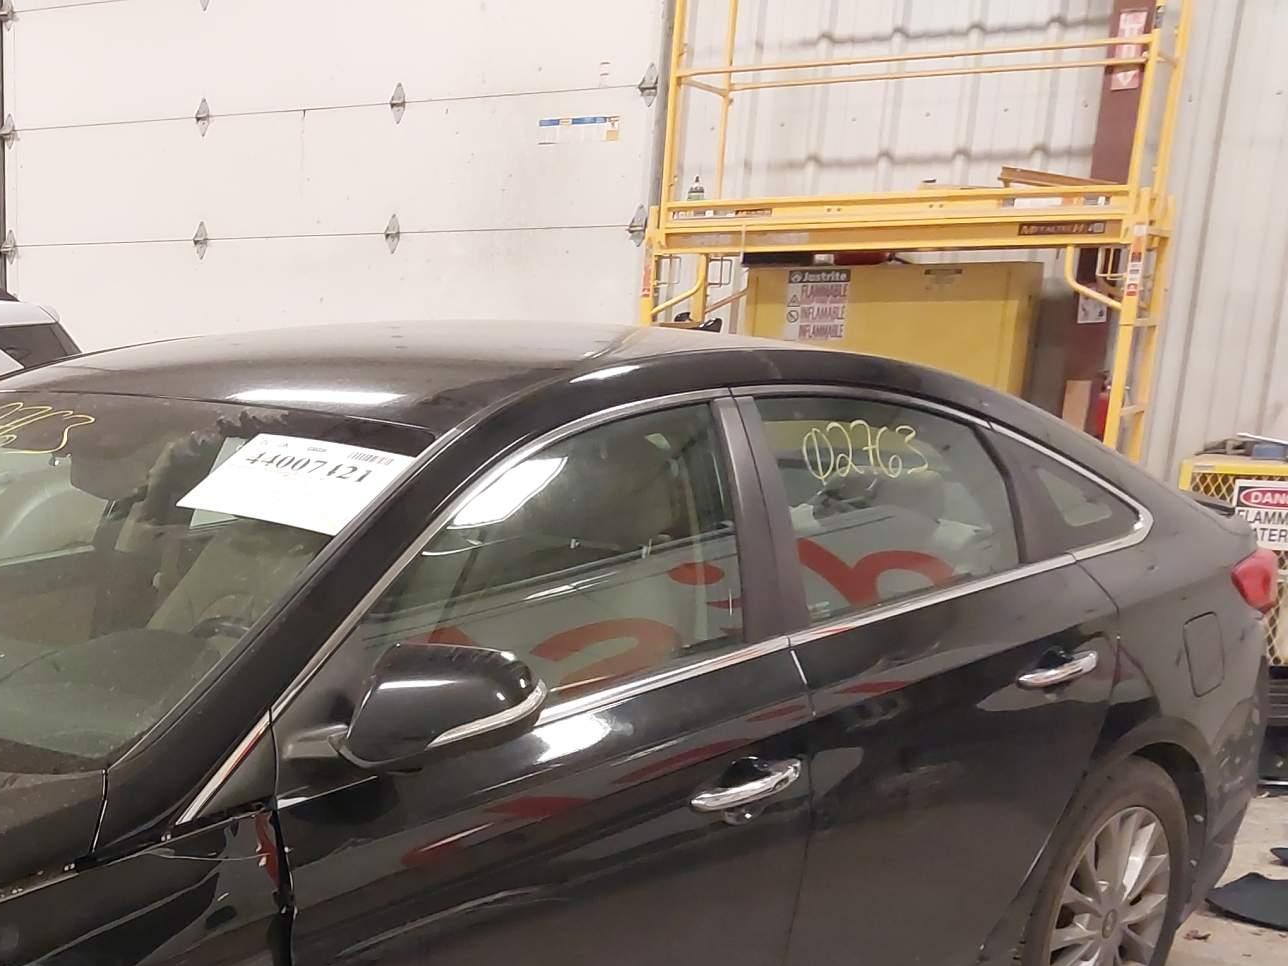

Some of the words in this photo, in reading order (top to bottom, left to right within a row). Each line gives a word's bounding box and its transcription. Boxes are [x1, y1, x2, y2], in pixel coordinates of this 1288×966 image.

[802, 271, 847, 282] Justrite
[803, 420, 928, 485] 02763
[1250, 491, 1288, 506] DAN
